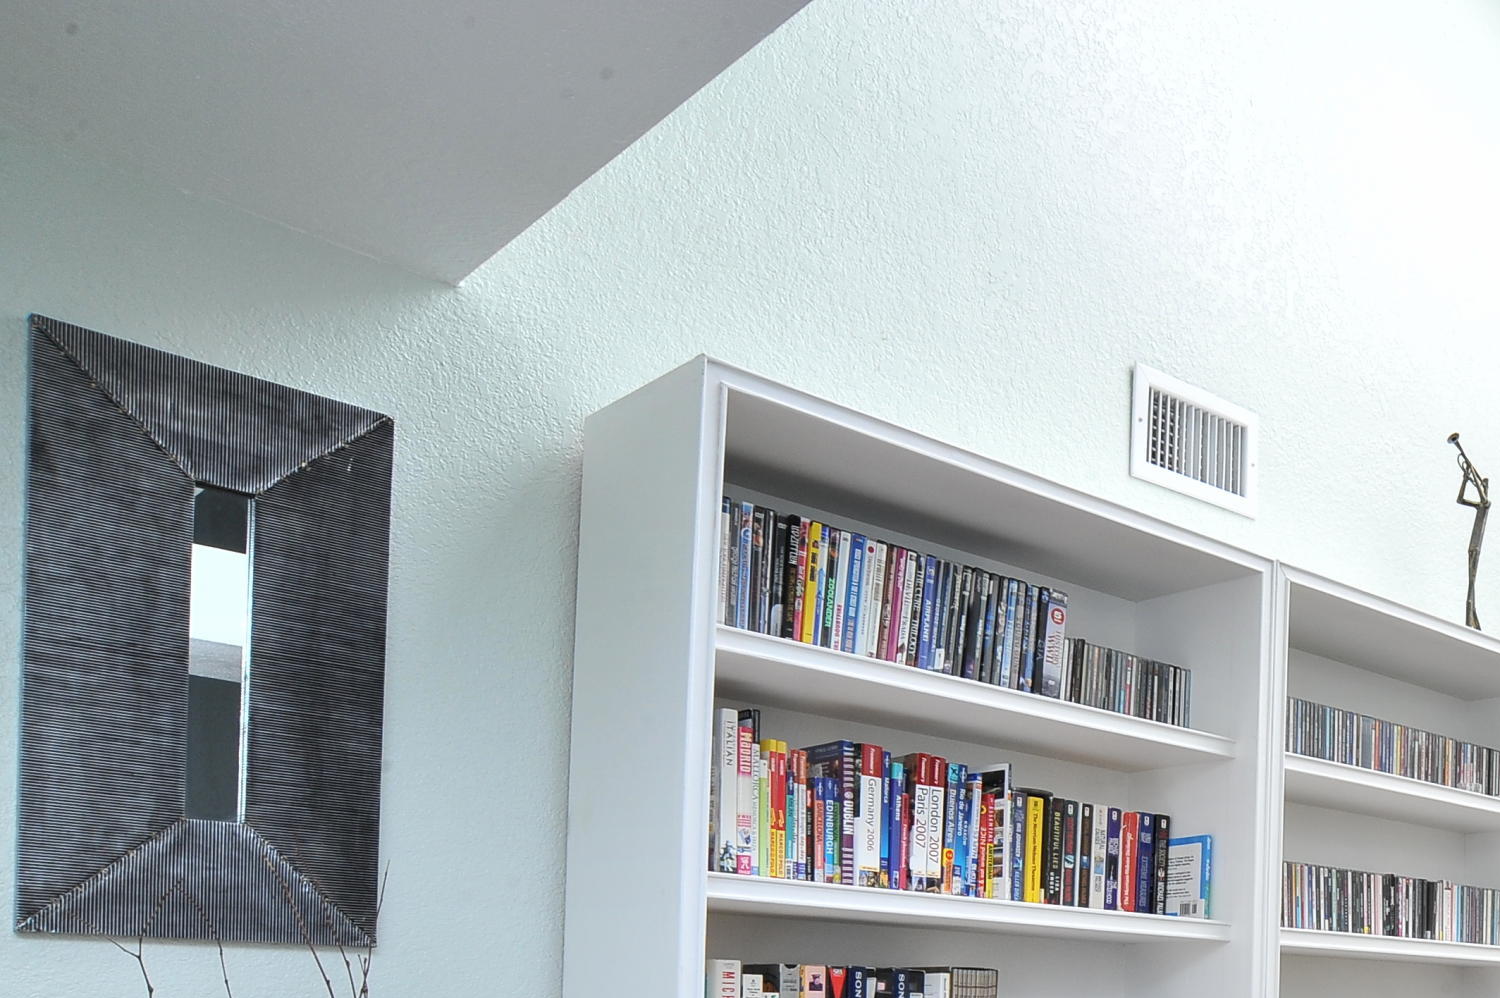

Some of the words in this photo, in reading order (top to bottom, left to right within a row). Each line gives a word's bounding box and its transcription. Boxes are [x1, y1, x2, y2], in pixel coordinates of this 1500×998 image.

[824, 578, 835, 627] ZOOLANDER
[913, 587, 922, 611] CURE
[908, 619, 920, 656] TRILOGY
[1036, 640, 1045, 660] GIA
[725, 720, 735, 766] ITALIAN
[866, 778, 877, 827] Germany
[894, 794, 902, 821] Athens
[916, 787, 928, 814] Paris
[929, 789, 941, 832] London
[815, 803, 823, 842] BARCELONA
[826, 800, 834, 854] EDINBURGH
[843, 801, 854, 834] DUBLIN
[947, 821, 955, 843] Aires
[866, 829, 875, 852] 2006
[915, 819, 926, 848] 2007
[928, 836, 939, 864] 2007
